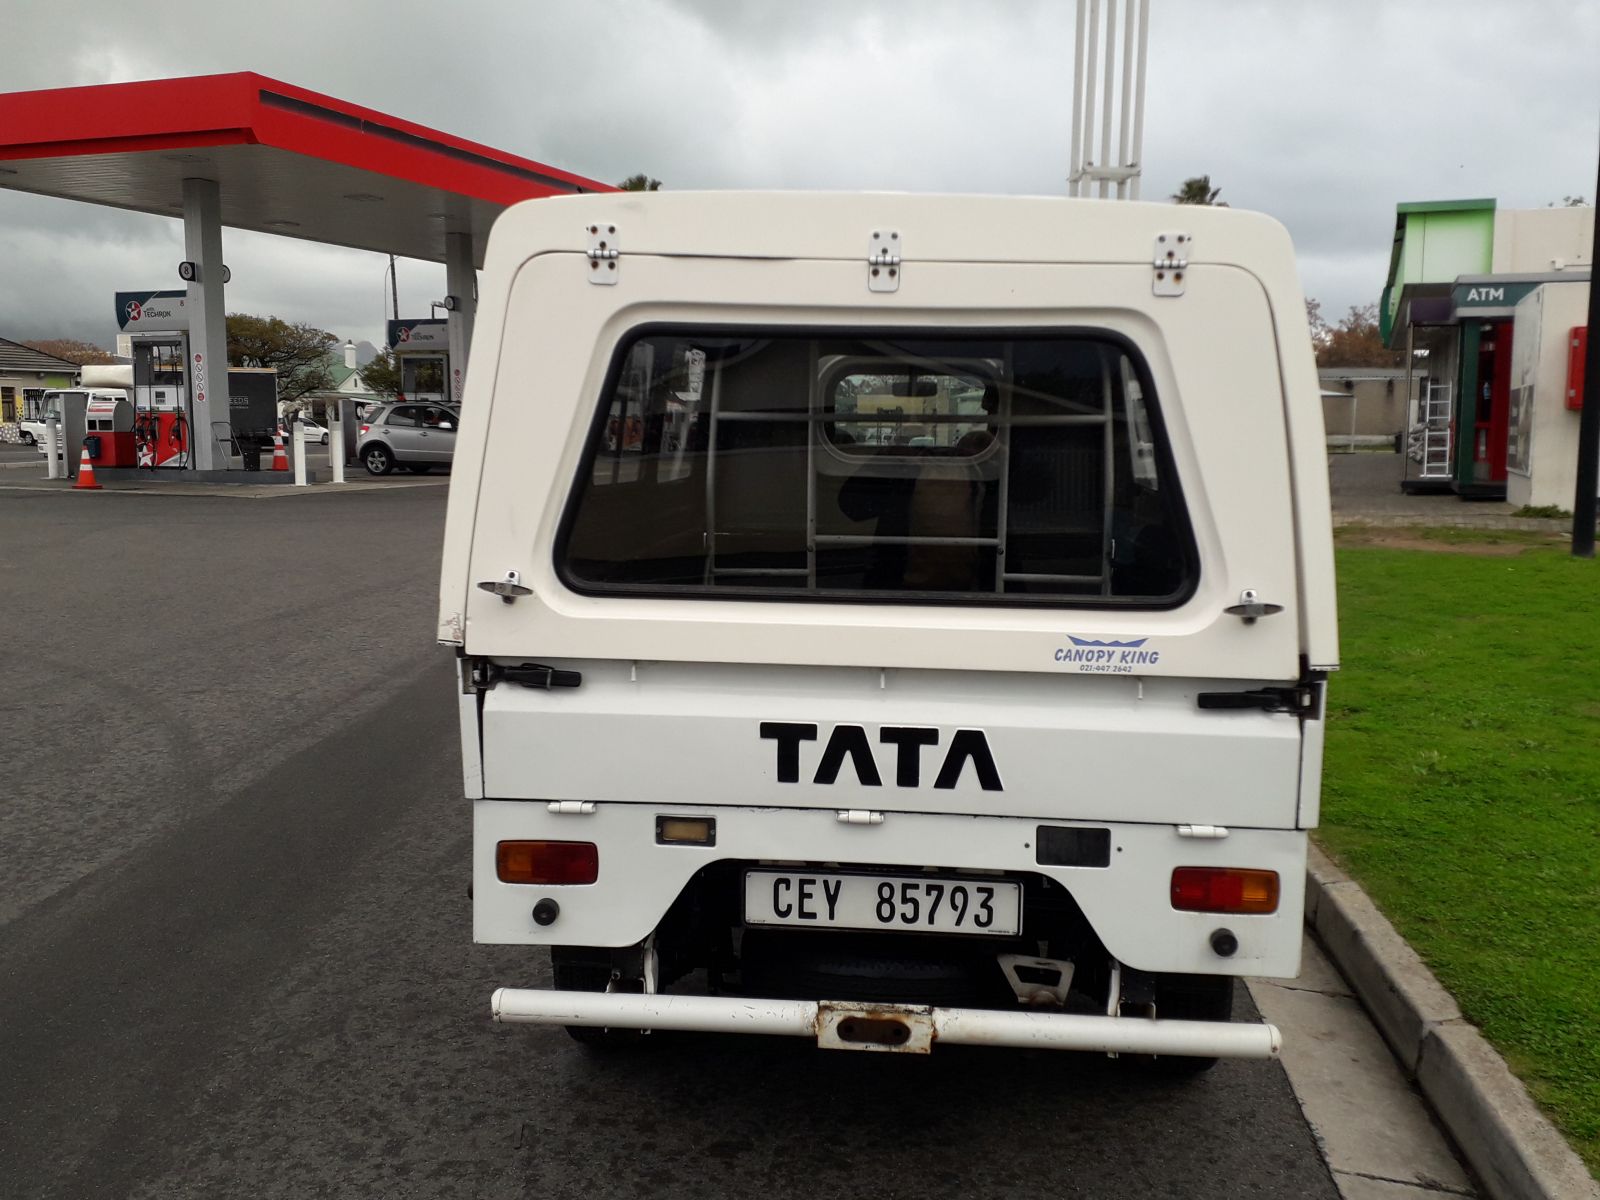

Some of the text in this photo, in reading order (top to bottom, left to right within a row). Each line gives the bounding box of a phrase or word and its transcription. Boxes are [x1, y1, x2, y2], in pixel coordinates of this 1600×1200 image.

[183, 265, 190, 275] 8
[1467, 287, 1505, 301] ATM
[143, 310, 172, 319] TECHRON
[1054, 648, 1160, 665] CANOPY KING
[759, 721, 1004, 792] TATA
[773, 877, 995, 929] CEY 85793
